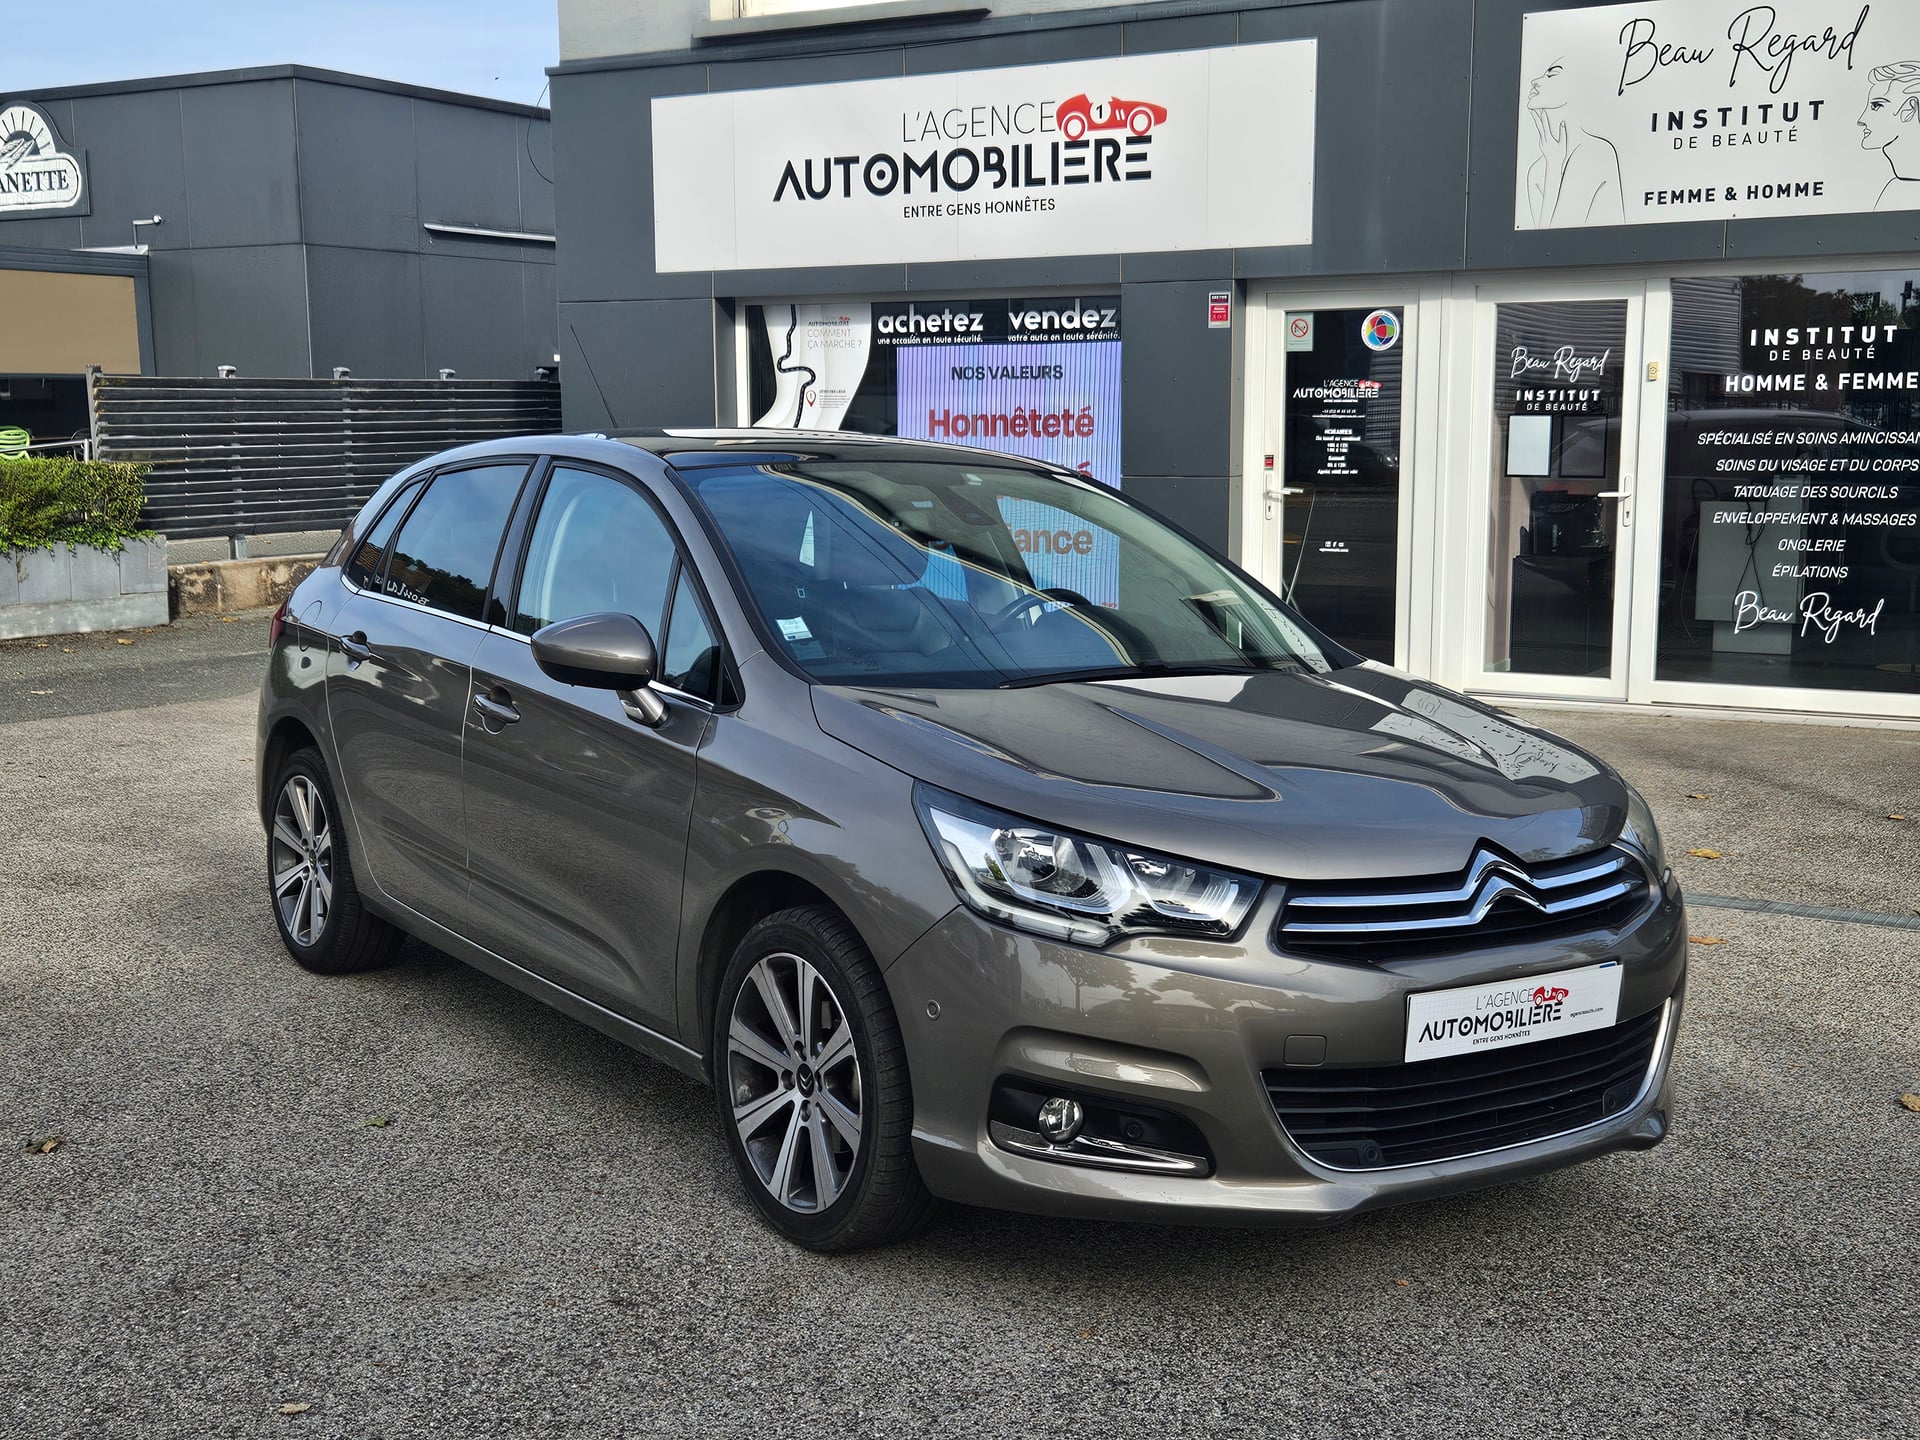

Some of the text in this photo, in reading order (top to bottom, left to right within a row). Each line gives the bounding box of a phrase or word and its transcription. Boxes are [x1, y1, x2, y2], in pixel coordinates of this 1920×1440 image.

[1618, 5, 1869, 96] Beau Regard
[1651, 100, 1825, 132] INSTITUT
[1673, 127, 1798, 150] DE BEAUTÉ
[1644, 181, 1825, 206] FEMME & HOMME
[903, 197, 1056, 219] ENTRE GENS HONNÊTES
[878, 299, 1117, 333] achetez vendez
[807, 329, 851, 338] COMMENT
[1750, 325, 1898, 347] INSTITUT
[820, 340, 855, 349] MARCHE
[1769, 345, 1875, 361] DE BEAUTÉ
[1511, 345, 1610, 383] Beau Regard
[951, 365, 1064, 381] NOS VALEURS
[1725, 371, 1918, 392] HOMME & FEMME
[1516, 390, 1600, 402] INSTITUT
[1527, 402, 1587, 411] DE BEAUTÉ
[929, 405, 1094, 438] Honnêteté
[1698, 430, 1773, 445] SPÉCIALISÉ
[1775, 433, 1794, 445] EN
[1796, 432, 1837, 445] SOINS
[1716, 459, 1919, 472] SOINS DU VISAGE ET DU CORPS
[1733, 486, 1899, 499] TATOUAGE DES SOURCILS
[1713, 512, 1917, 526] ENVELOPPEMENT & MASSAGES
[1005, 523, 1093, 555] ance
[1778, 539, 1846, 552] ONGLERIE
[1772, 563, 1848, 579] ÉPILATIONS
[1734, 590, 1884, 644] Beau Regard
[1473, 1036, 1489, 1045] ENTRE
[1490, 1034, 1504, 1043] GENS
